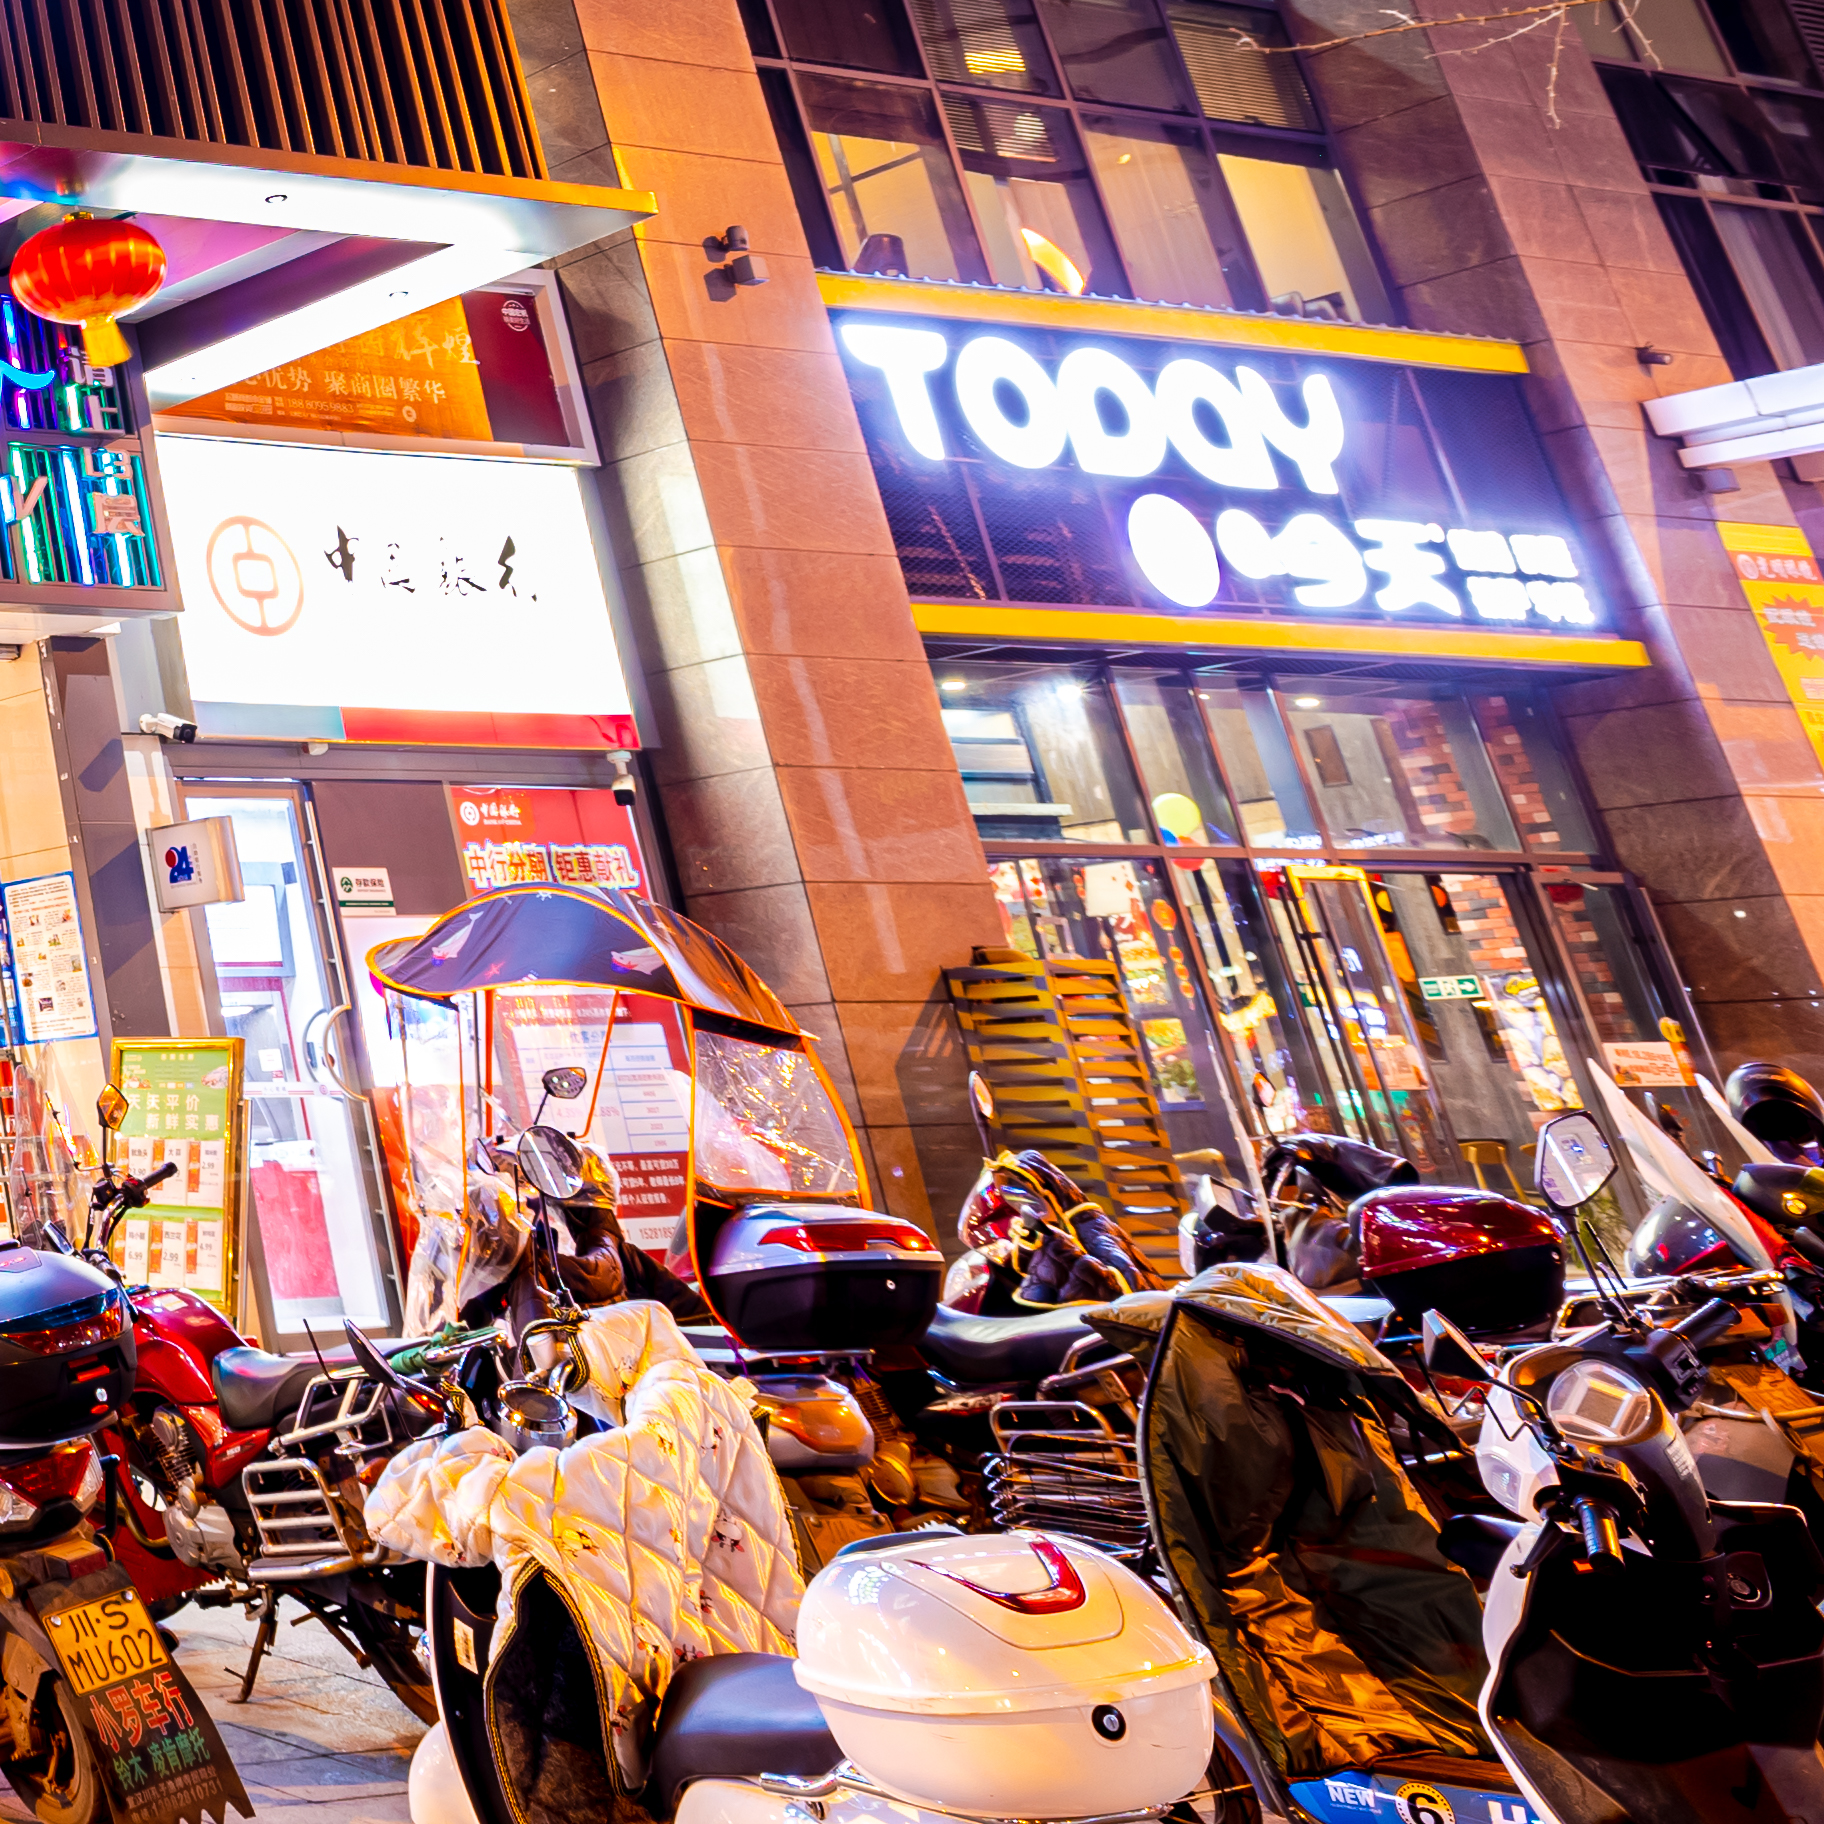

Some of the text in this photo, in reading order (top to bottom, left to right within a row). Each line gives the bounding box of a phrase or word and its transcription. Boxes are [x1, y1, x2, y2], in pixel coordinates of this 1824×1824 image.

[145, 1113, 220, 1131] 新鲜实惠
[128, 1251, 144, 1262] 6.99
[66, 1628, 164, 1690] MU602
[89, 1671, 195, 1754] 小罗车行
[1328, 1784, 1376, 1807] NEW
